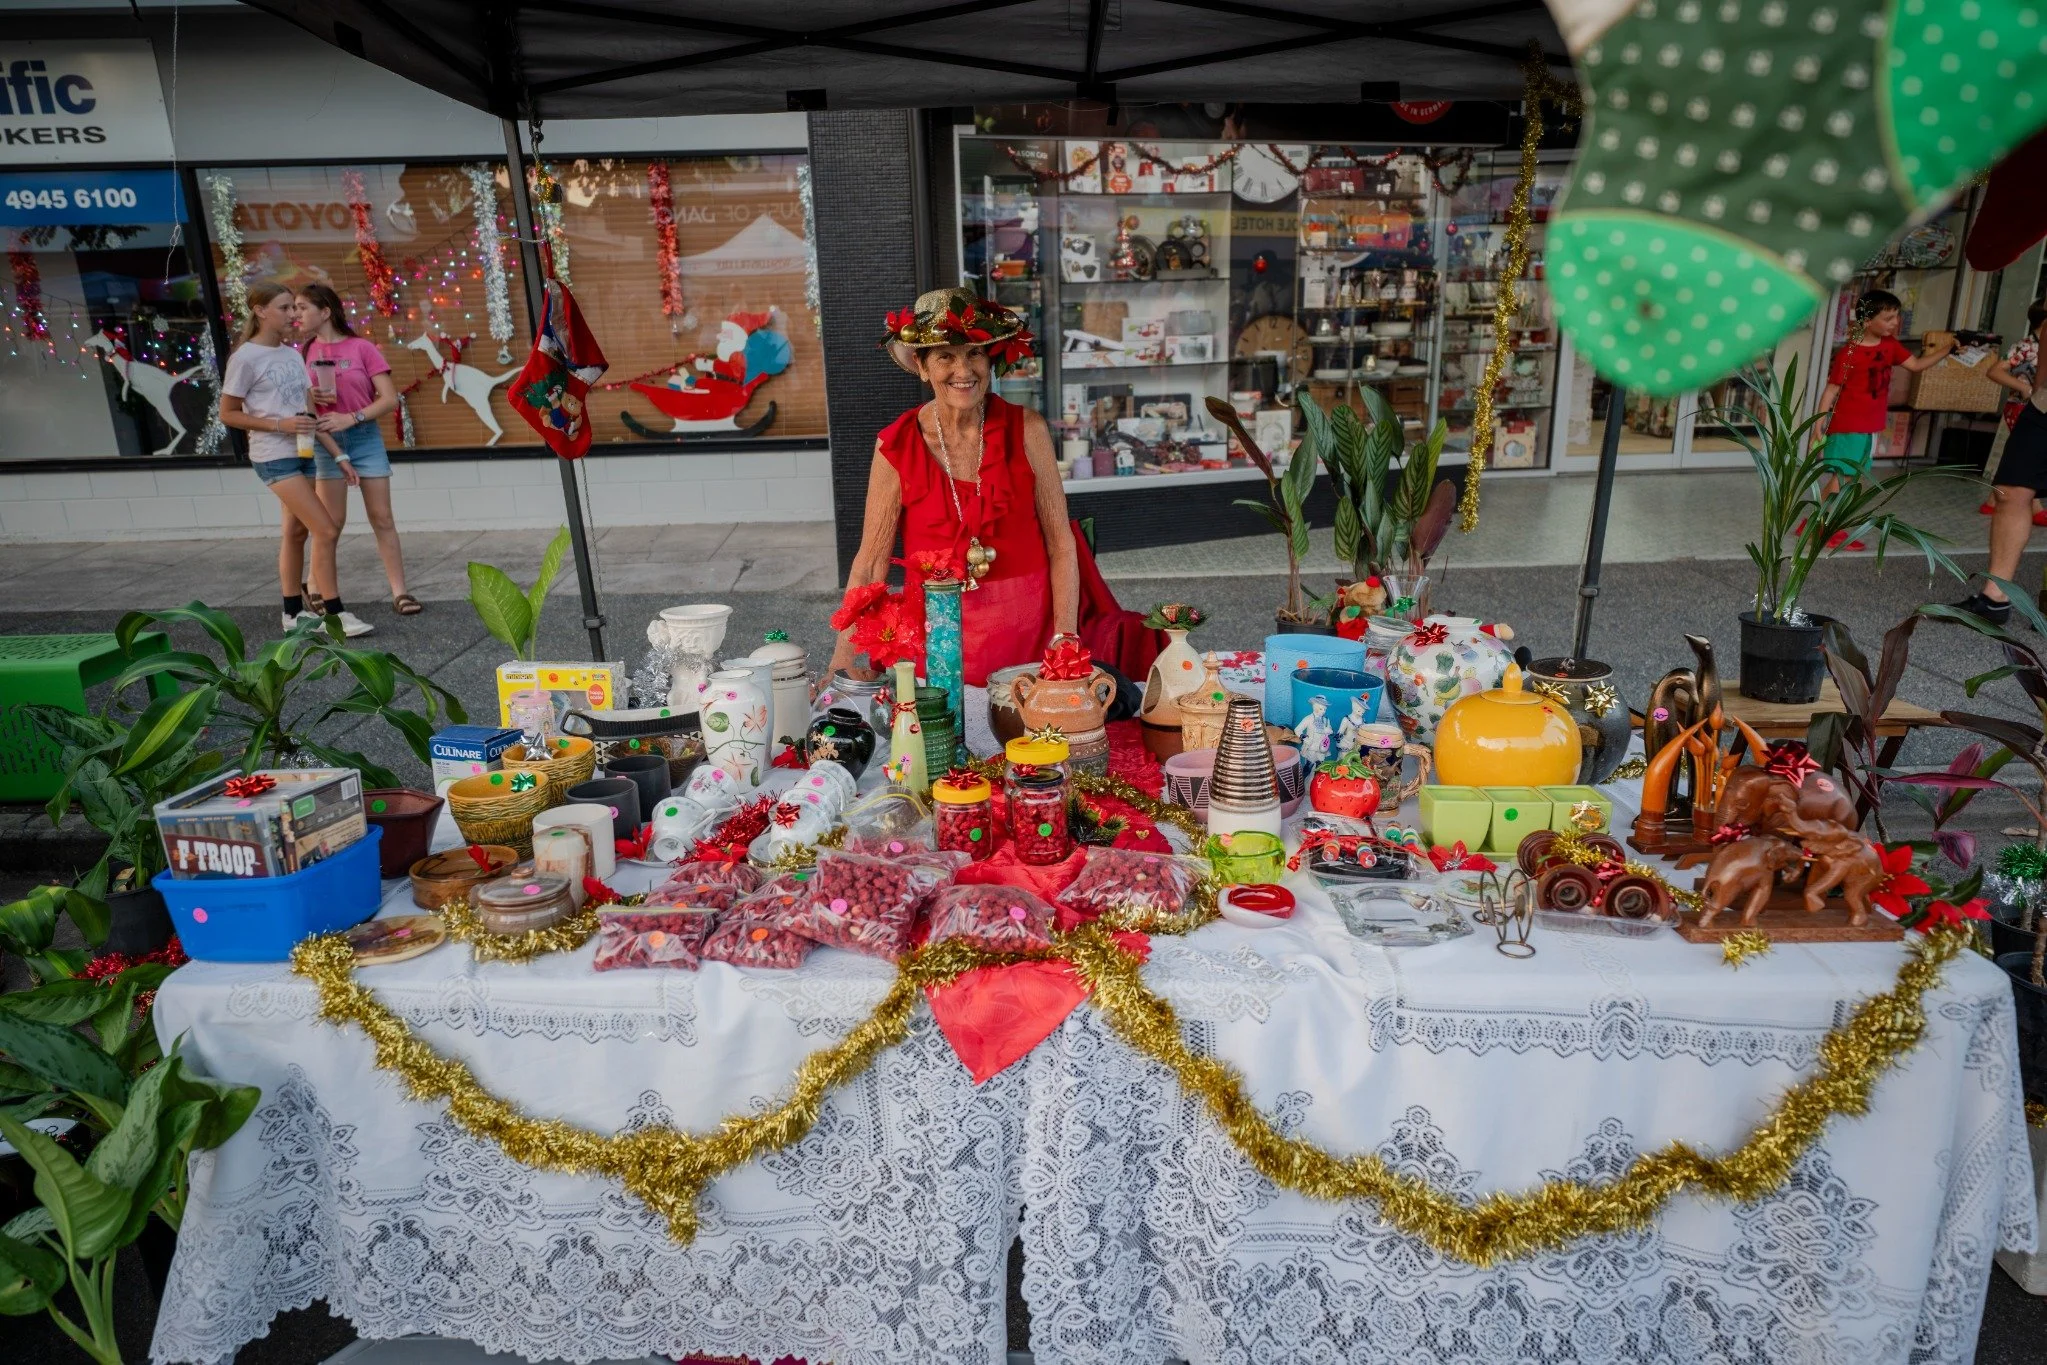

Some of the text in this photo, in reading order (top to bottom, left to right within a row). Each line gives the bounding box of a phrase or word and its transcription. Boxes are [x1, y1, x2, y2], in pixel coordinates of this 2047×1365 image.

[0, 127, 106, 145] KERS
[5, 188, 137, 210] 4945 6100
[433, 743, 482, 759] CULINARE
[177, 839, 256, 876] F TROOP
